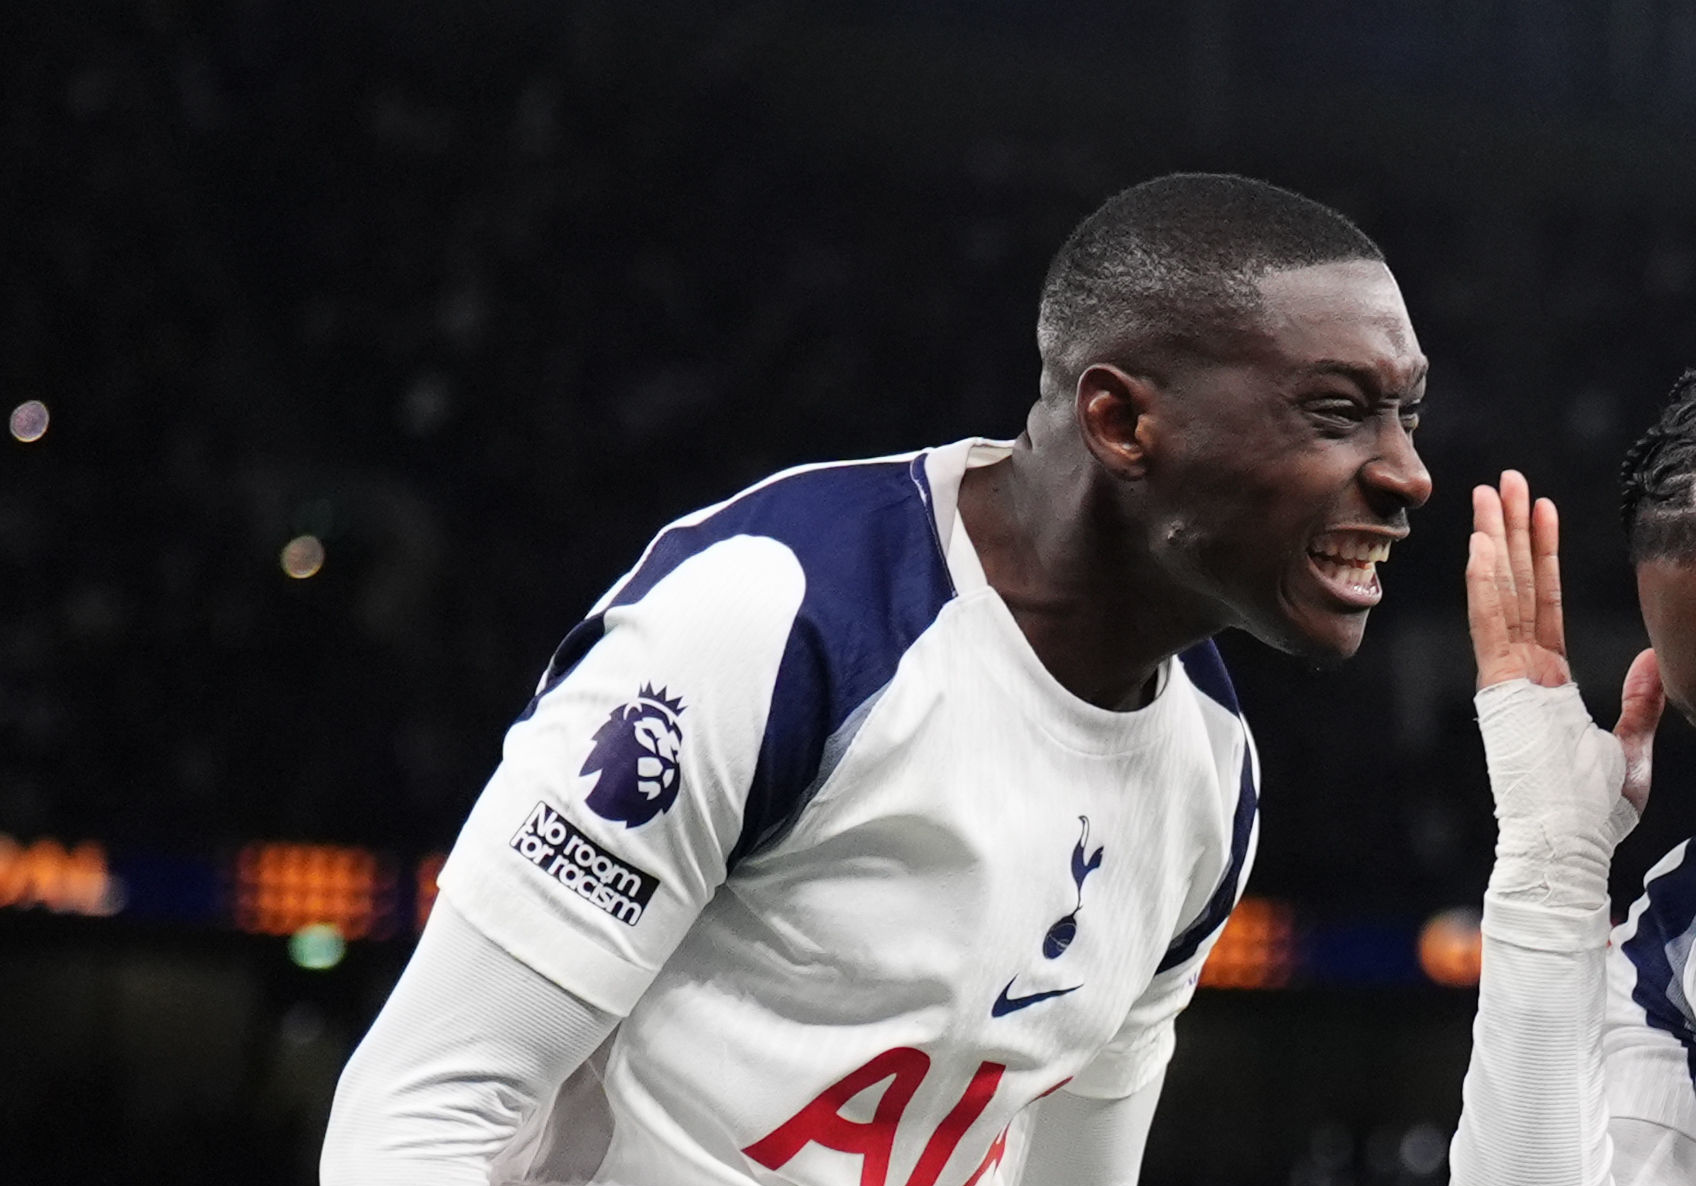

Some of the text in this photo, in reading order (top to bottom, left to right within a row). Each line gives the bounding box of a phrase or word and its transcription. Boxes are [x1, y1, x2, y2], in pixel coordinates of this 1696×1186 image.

[512, 823, 644, 926] for racism
[525, 801, 642, 898] No room
